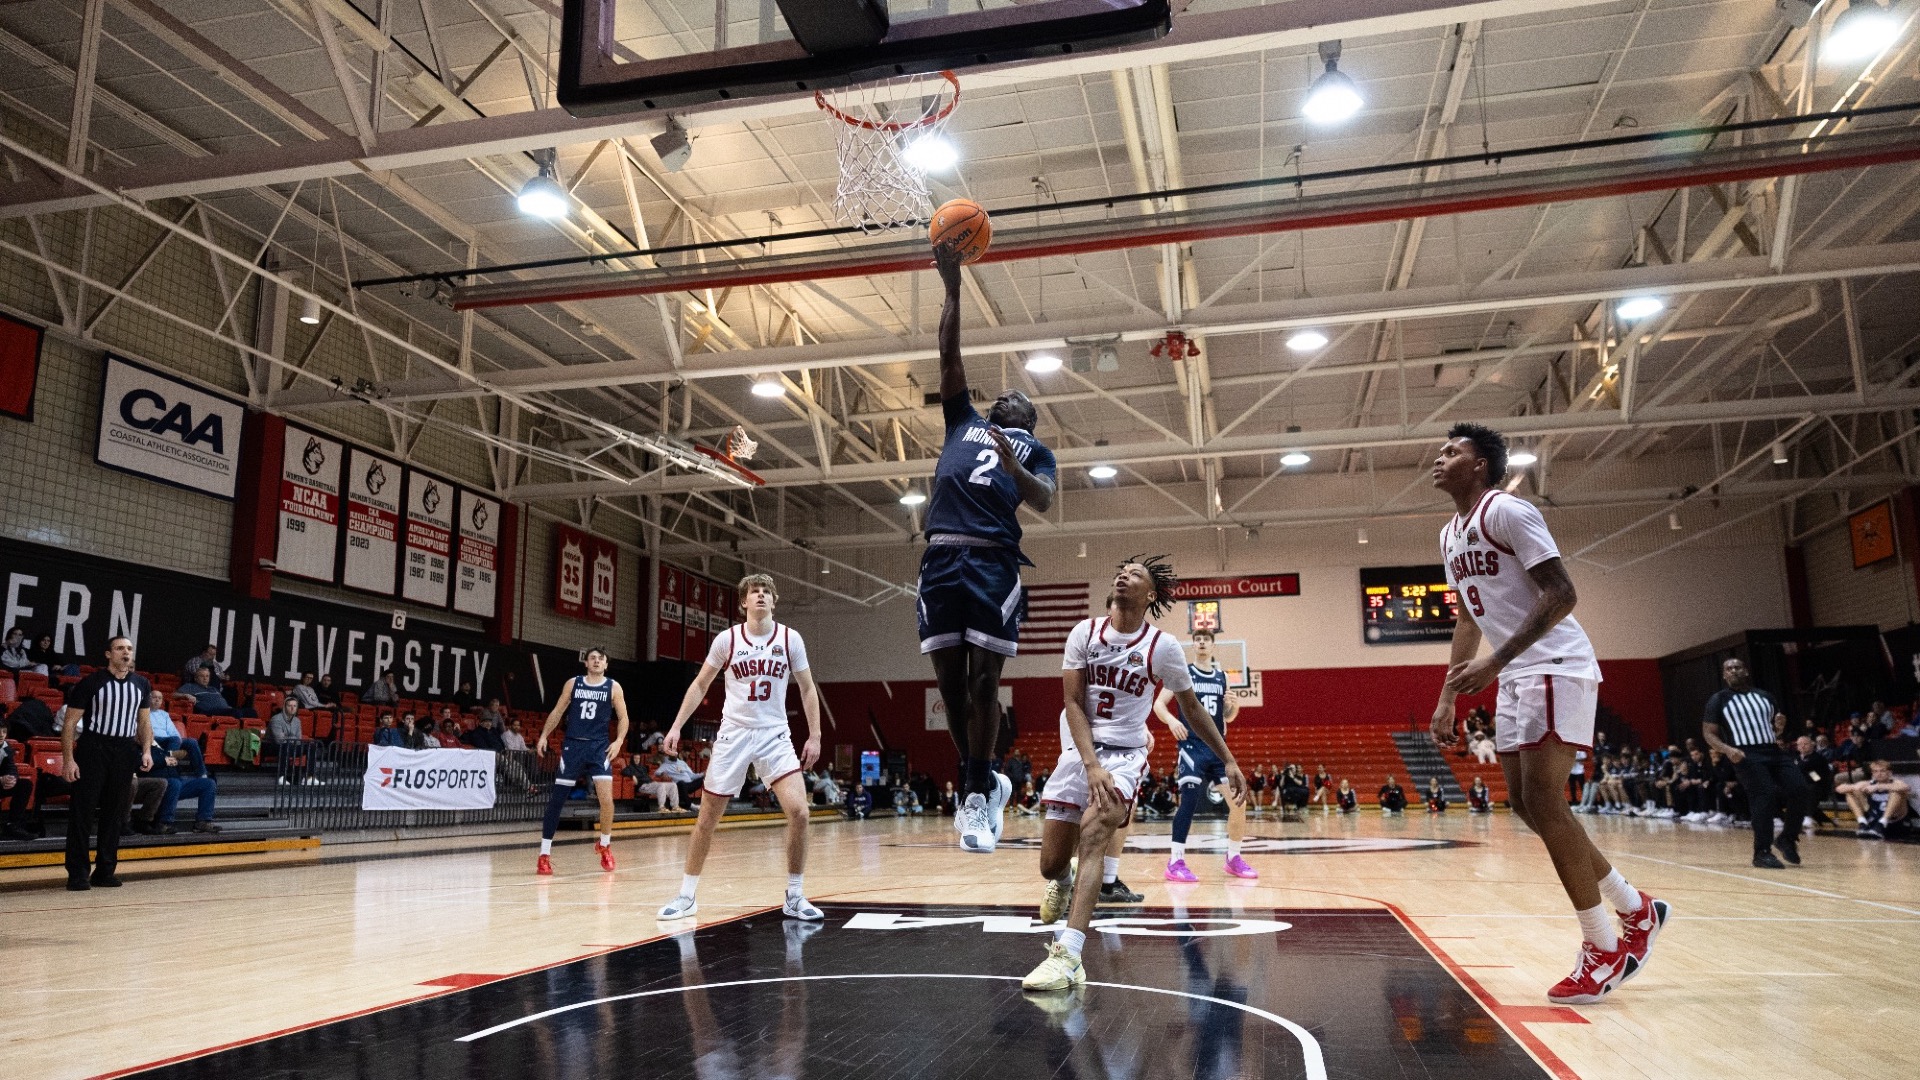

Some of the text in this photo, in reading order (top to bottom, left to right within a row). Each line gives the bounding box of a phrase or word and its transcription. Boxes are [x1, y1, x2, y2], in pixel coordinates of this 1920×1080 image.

[120, 389, 223, 454] CAA
[110, 429, 229, 471] COASTAL ATHLETIC ASSOCIATION
[968, 449, 998, 486] 2
[286, 471, 308, 484] WOMEN'S
[293, 486, 327, 510] NCAA
[283, 500, 335, 523] TOURNAMENT
[287, 518, 305, 532] 1999
[349, 519, 394, 540] CHAMPIONS
[409, 524, 449, 542] AMERICA EAST
[350, 536, 369, 549] 2023
[408, 533, 449, 552] CHAMPIONS
[410, 566, 424, 578] 1987
[564, 564, 579, 586] 35
[598, 574, 609, 595] 10
[1237, 580, 1283, 593] Court
[1401, 585, 1427, 597] 5:22
[1196, 602, 1218, 613] 5:22
[1370, 596, 1384, 607] 35
[1444, 592, 1457, 604] 30
[1467, 585, 1484, 617] 9
[395, 616, 403, 627] C
[1194, 613, 1215, 629] 25
[208, 607, 489, 700] UNIVERSITY
[731, 659, 787, 679] HUSKIES
[574, 689, 607, 702] MONMOUTH
[748, 680, 772, 701] 13
[579, 701, 597, 720] 13
[1097, 691, 1115, 719] 2
[1201, 695, 1218, 716] 15
